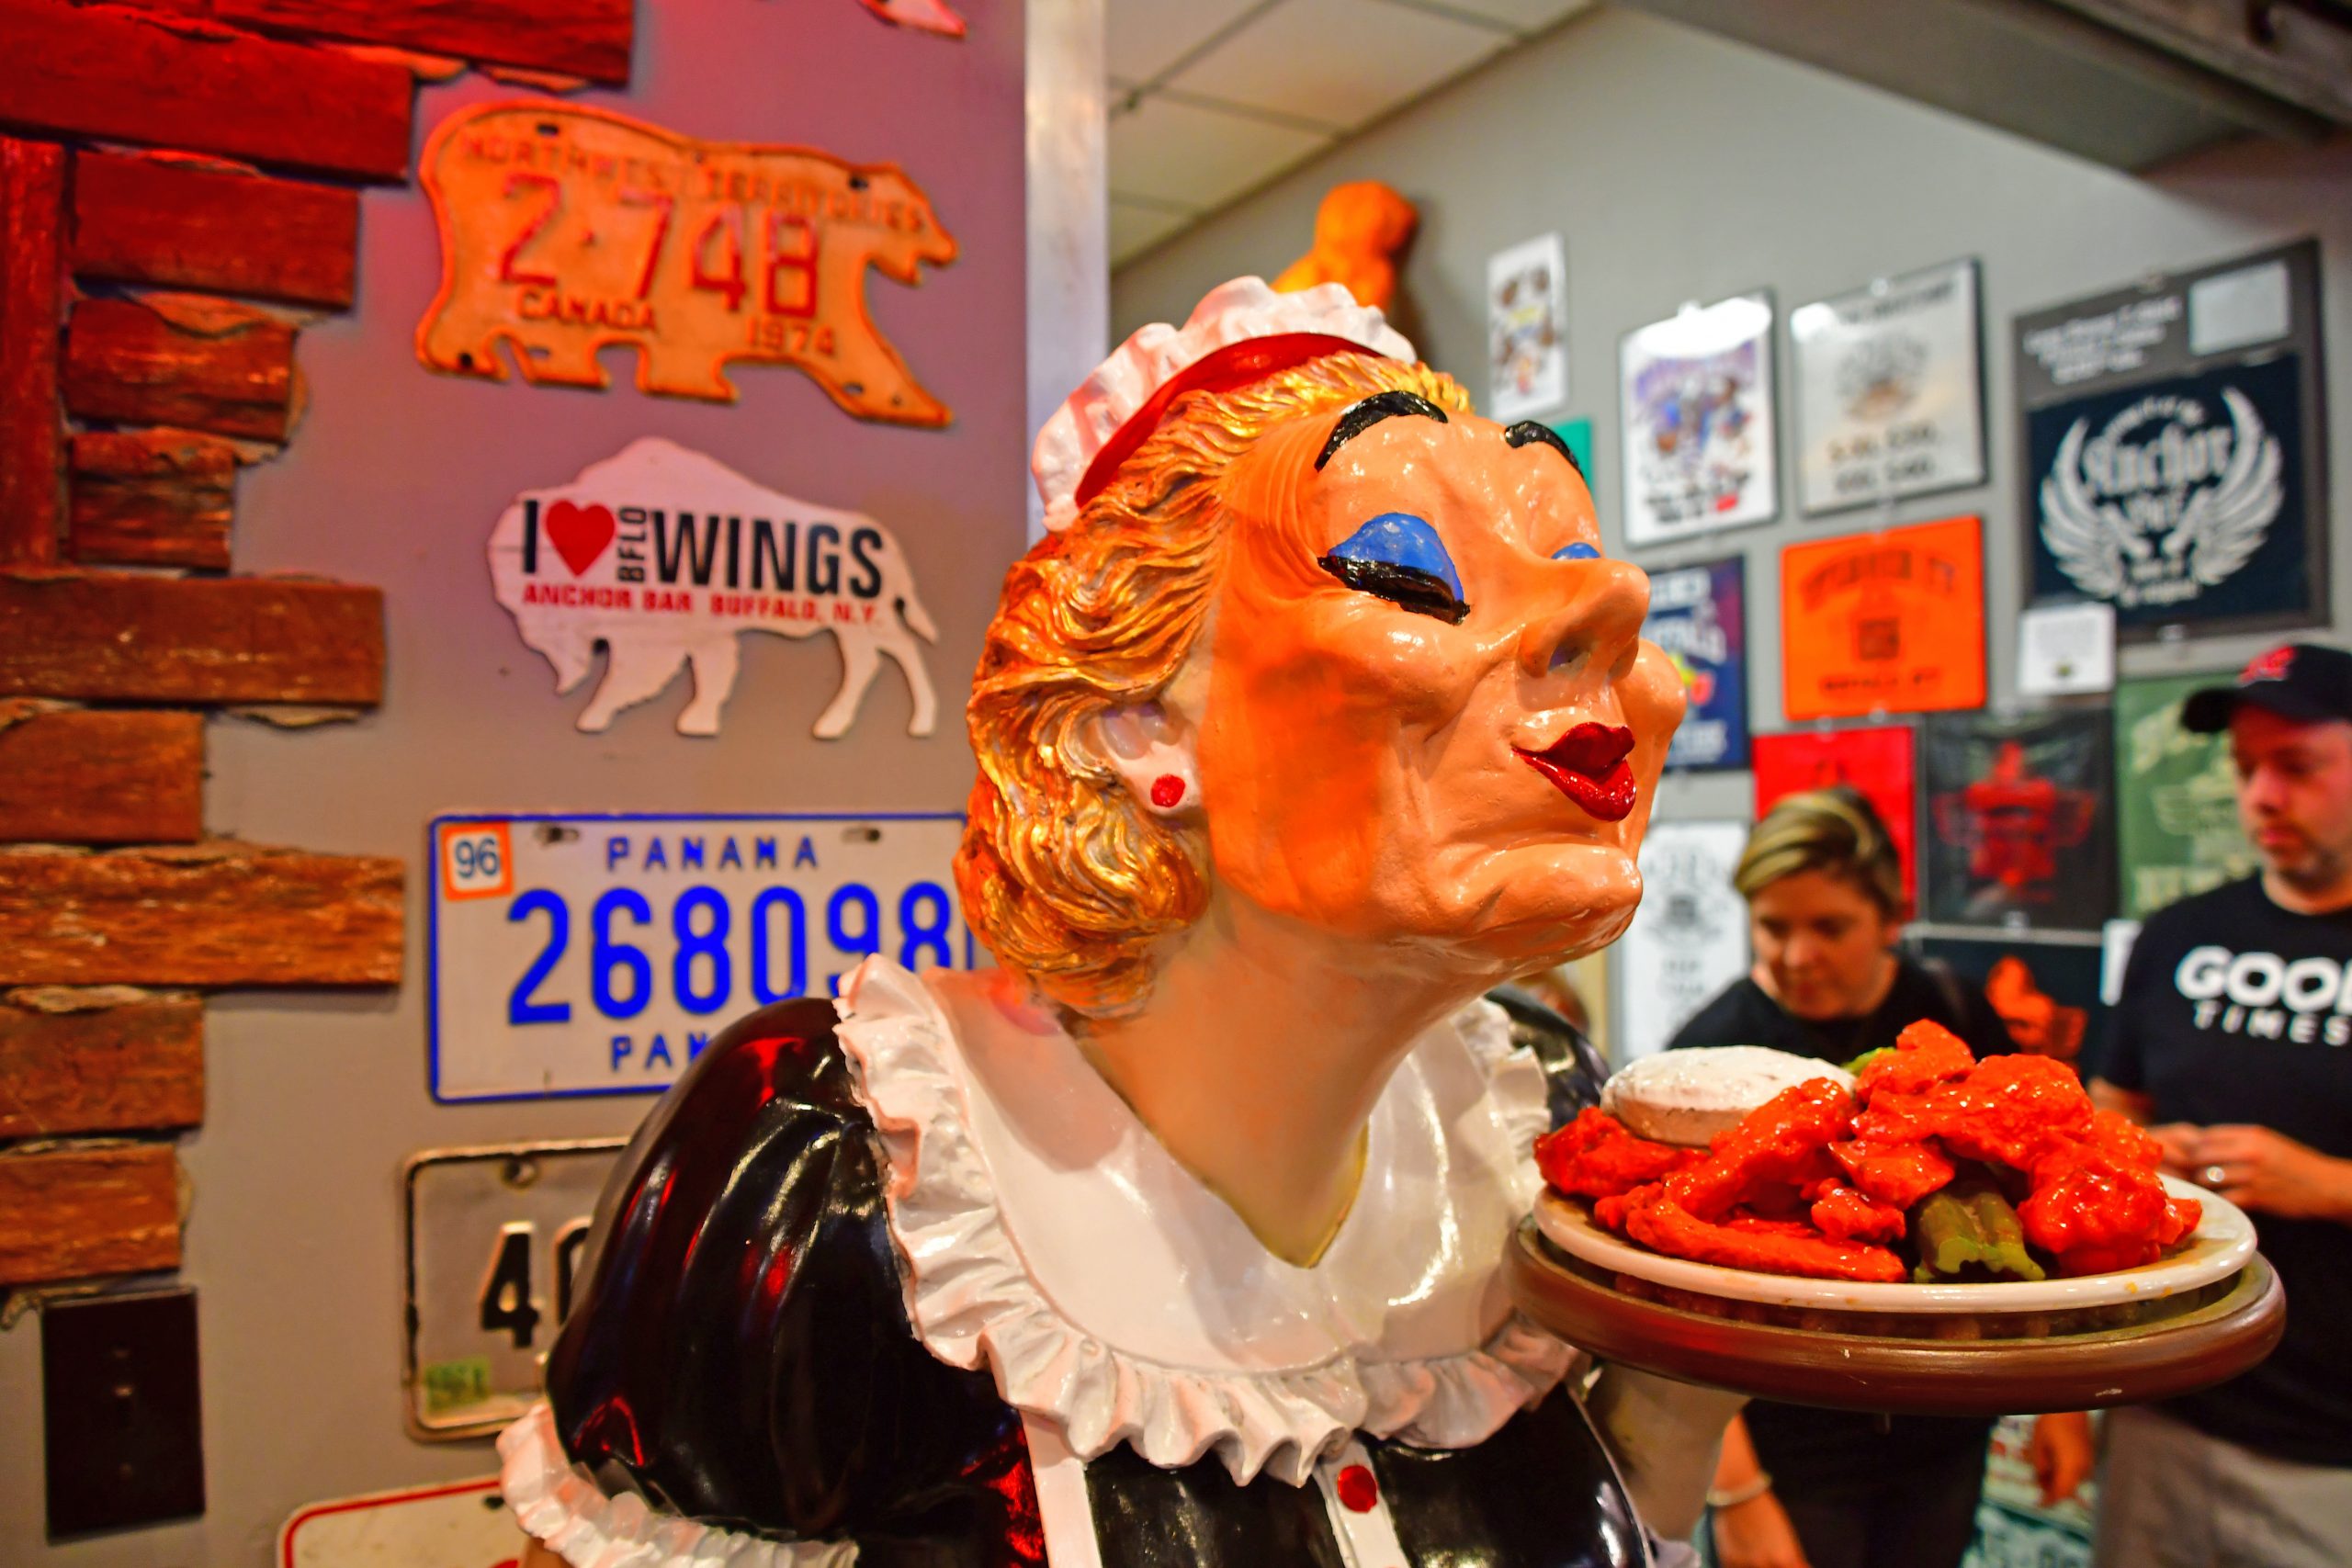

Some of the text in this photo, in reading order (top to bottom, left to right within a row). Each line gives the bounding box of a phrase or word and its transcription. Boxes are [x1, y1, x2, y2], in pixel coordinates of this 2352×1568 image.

[516, 289, 658, 333] CANADA
[748, 317, 837, 357] 1974
[522, 500, 540, 574] I
[616, 506, 649, 583] BFLO
[651, 509, 884, 600] WINGS
[523, 582, 632, 610] ANCHOR
[641, 591, 692, 615] BAR
[453, 837, 500, 879] 96
[608, 835, 820, 871] PANAMA
[506, 881, 952, 1027] 268098
[2193, 999, 2350, 1047] TIMES
